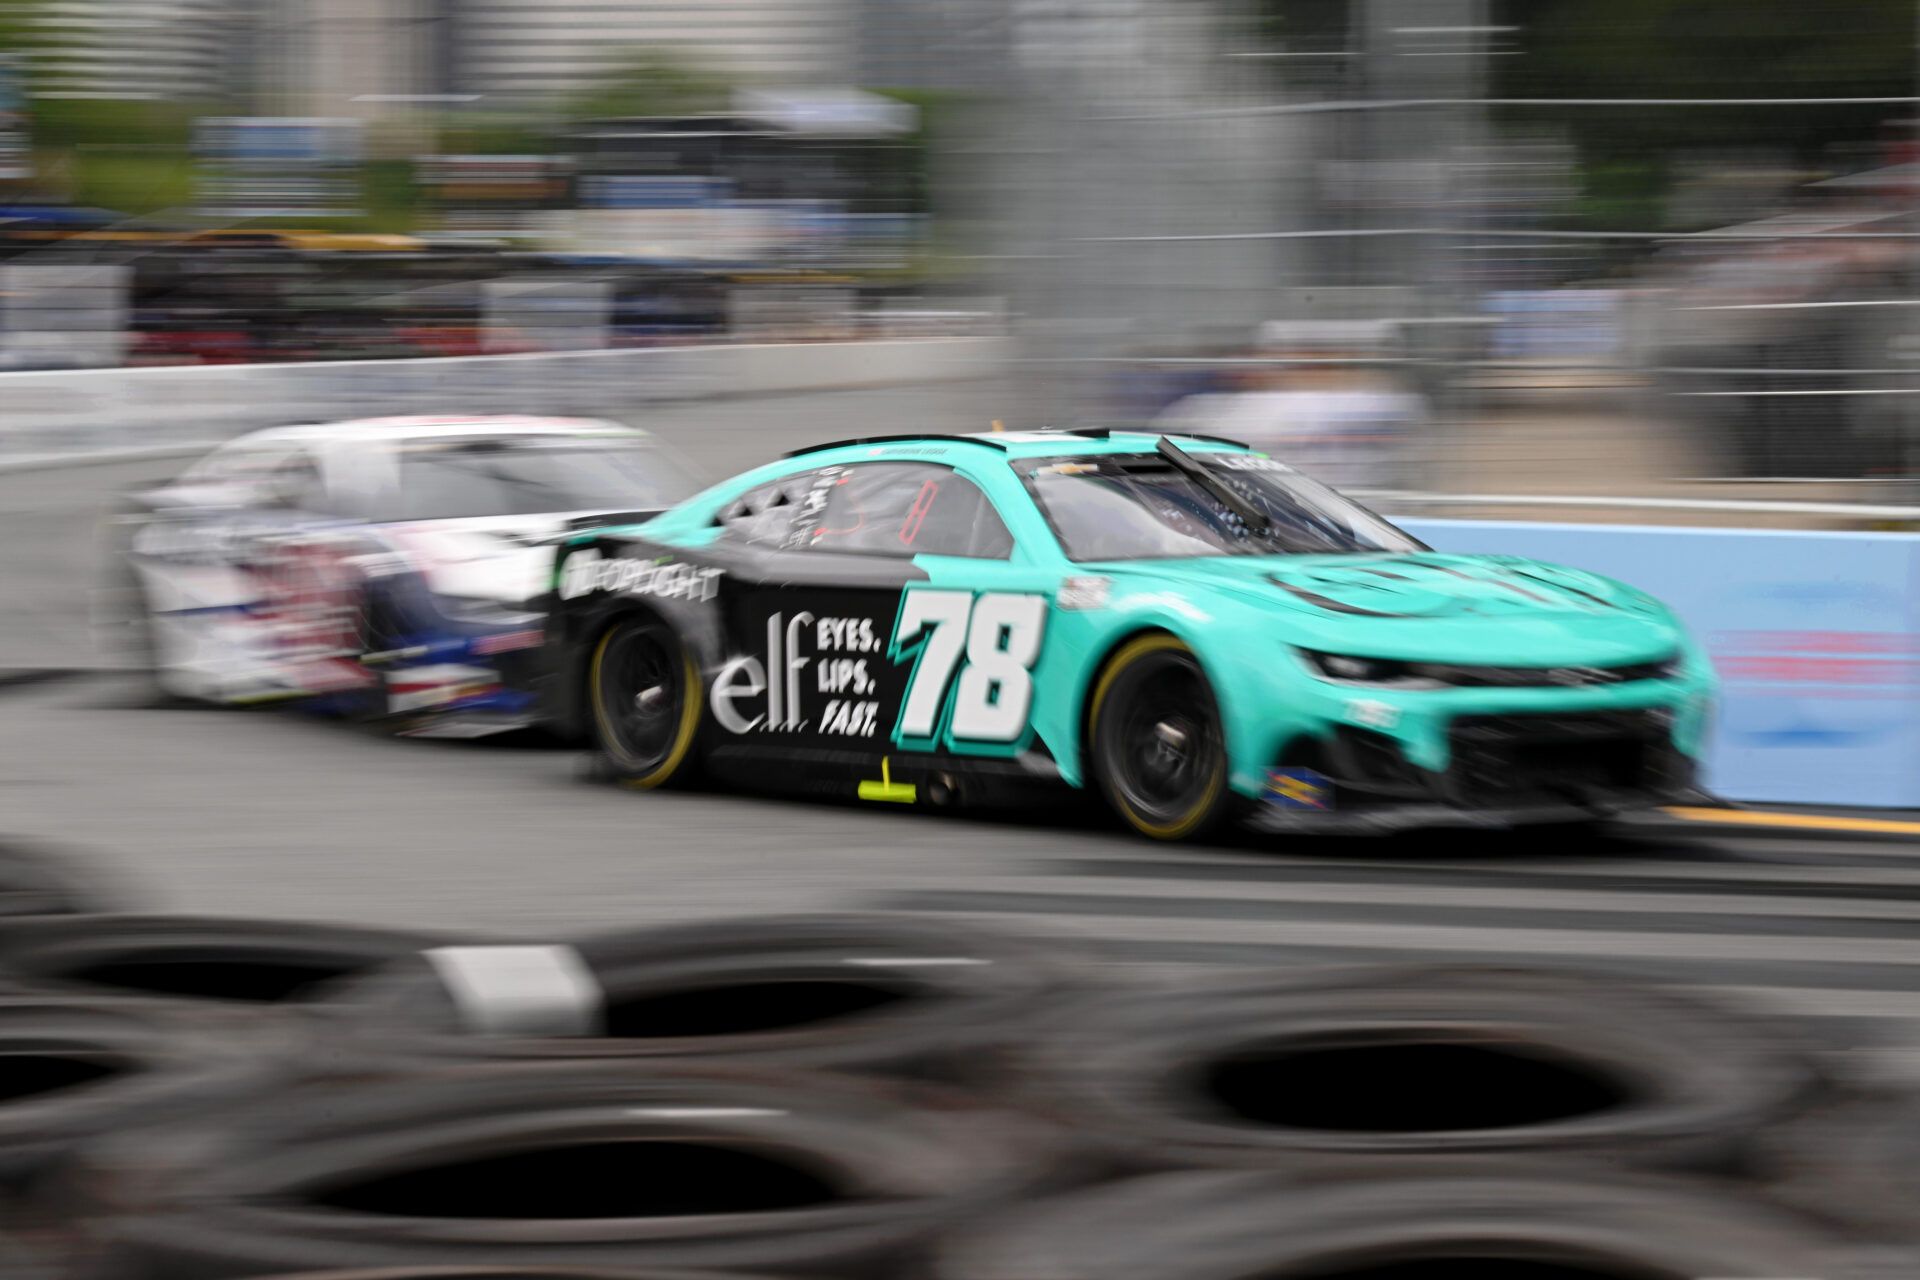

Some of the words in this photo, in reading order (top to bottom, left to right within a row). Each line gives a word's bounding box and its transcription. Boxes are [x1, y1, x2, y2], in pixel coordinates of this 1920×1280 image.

[817, 617, 881, 653] EYES.
[818, 658, 876, 695] LIPS.
[889, 586, 1050, 749] 78
[818, 700, 880, 738] FAST.
